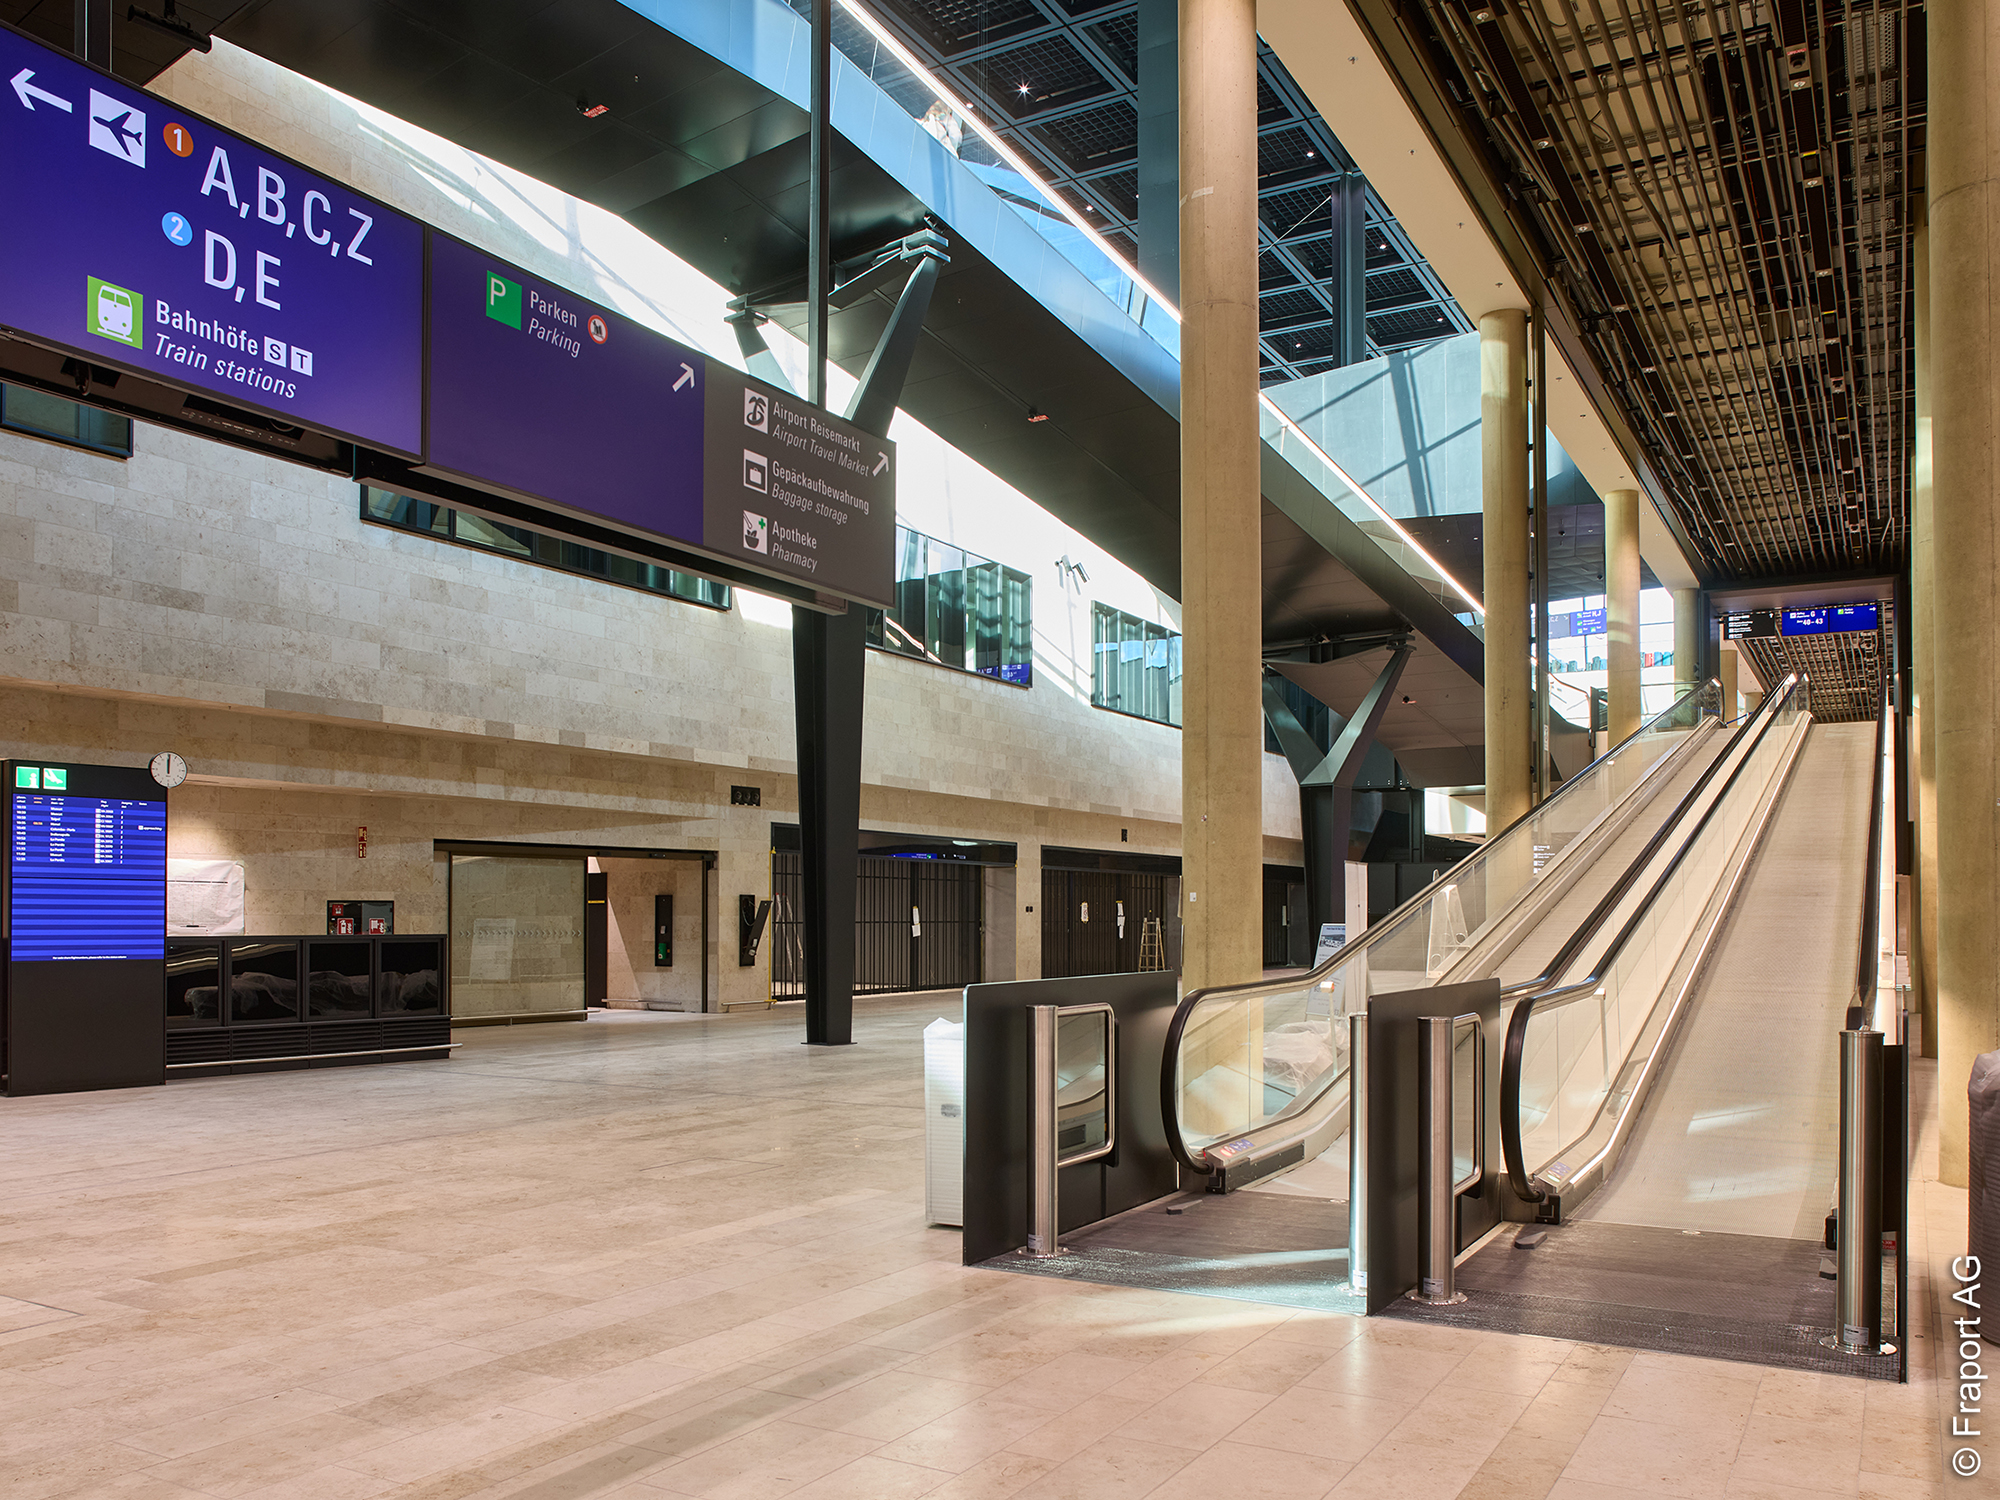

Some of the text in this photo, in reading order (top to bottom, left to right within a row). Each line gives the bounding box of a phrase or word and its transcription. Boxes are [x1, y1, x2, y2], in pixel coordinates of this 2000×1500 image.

[173, 128, 373, 266] 1 A,B,C,Z
[169, 215, 281, 311] 2 D,E
[490, 277, 506, 306] P
[530, 290, 577, 328] Parken
[156, 299, 259, 357] Bahnhöfe
[528, 317, 581, 358] Parking
[155, 333, 297, 399] Train stations
[772, 424, 869, 477] Airport Travel Market
[773, 401, 861, 454] Airport Reisemarkt
[771, 483, 848, 526] Baggage storage
[772, 460, 870, 515] Gepäckaufbewahrung
[771, 543, 818, 573] Pharmacy
[772, 521, 817, 549] Apotheke
